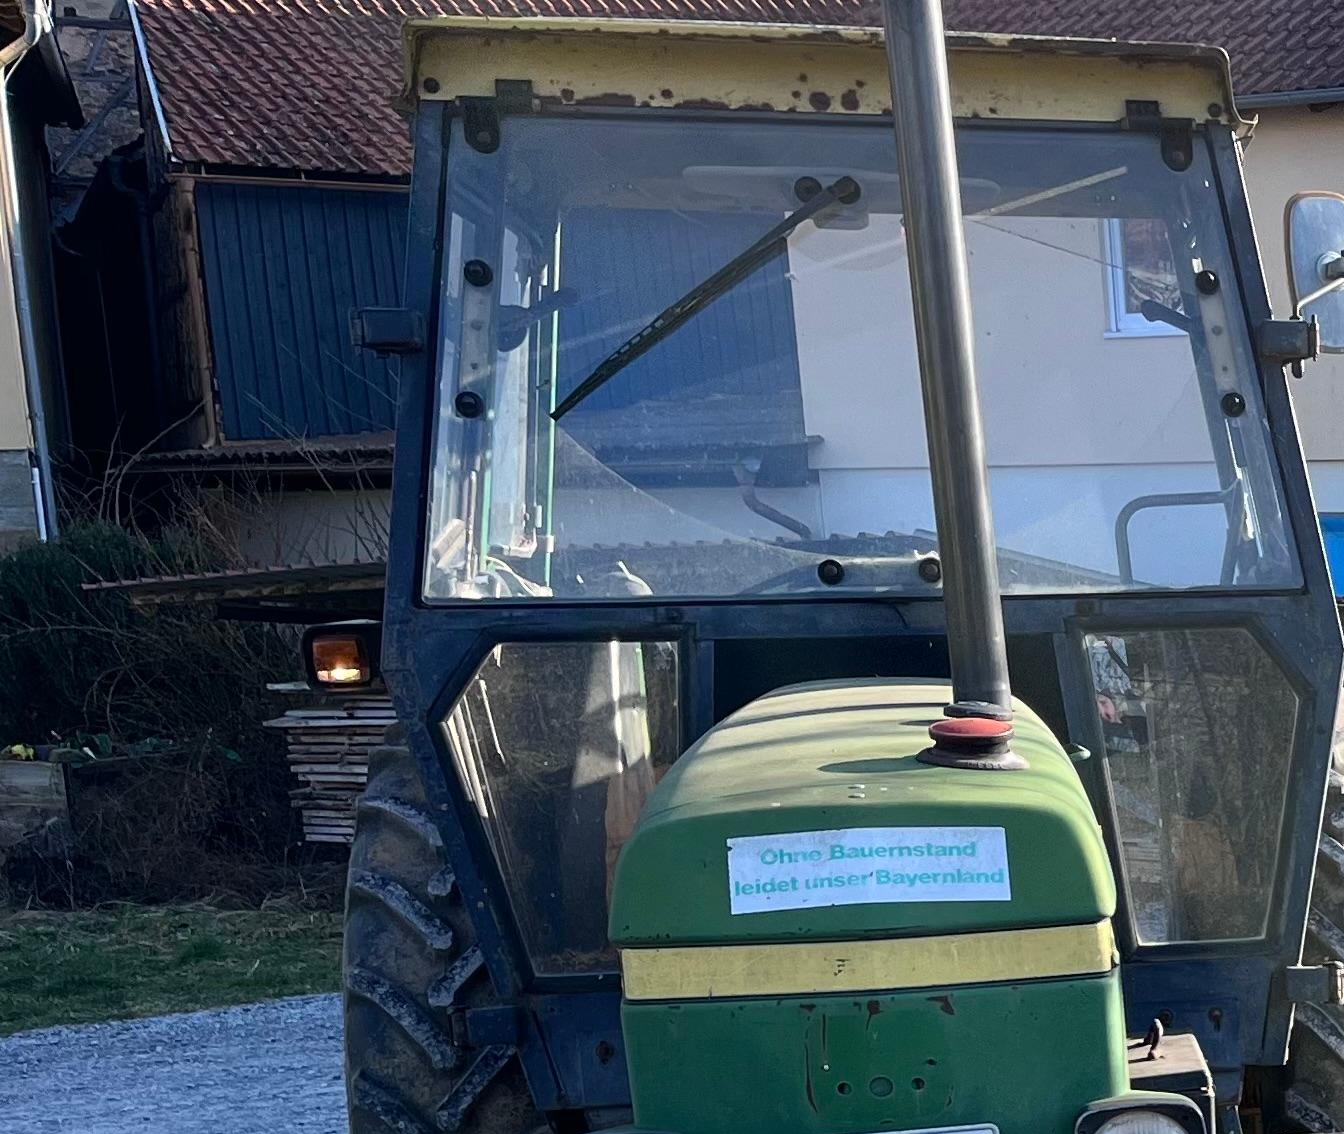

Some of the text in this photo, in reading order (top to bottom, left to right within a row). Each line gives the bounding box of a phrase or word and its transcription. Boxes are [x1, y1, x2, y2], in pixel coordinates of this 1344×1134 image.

[760, 841, 977, 865] Ohne Bauernstand
[734, 868, 1005, 897] leidet unser Bayernland
